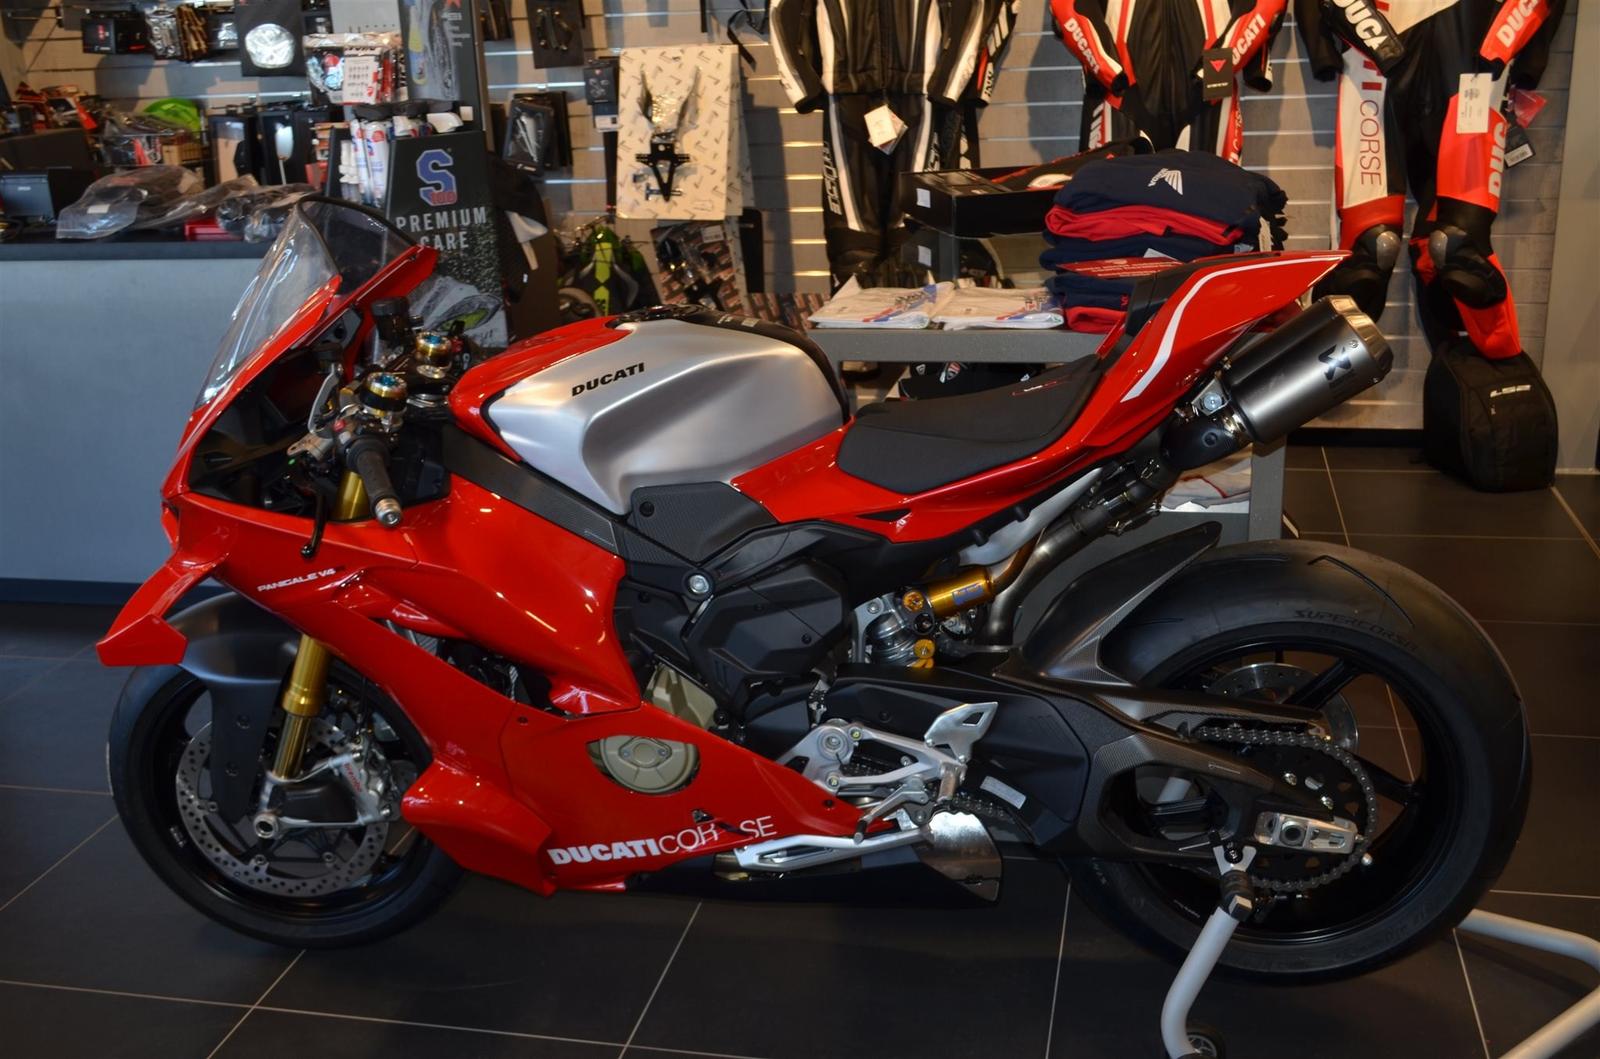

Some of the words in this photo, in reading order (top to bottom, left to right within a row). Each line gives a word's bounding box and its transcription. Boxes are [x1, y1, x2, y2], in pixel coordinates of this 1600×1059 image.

[1359, 100, 1382, 186] CORSE
[395, 207, 486, 232] PREMIUM
[420, 231, 470, 251] CARE
[571, 362, 645, 397] DUCATI
[257, 572, 318, 591] PANIGALE
[318, 568, 336, 577] V4
